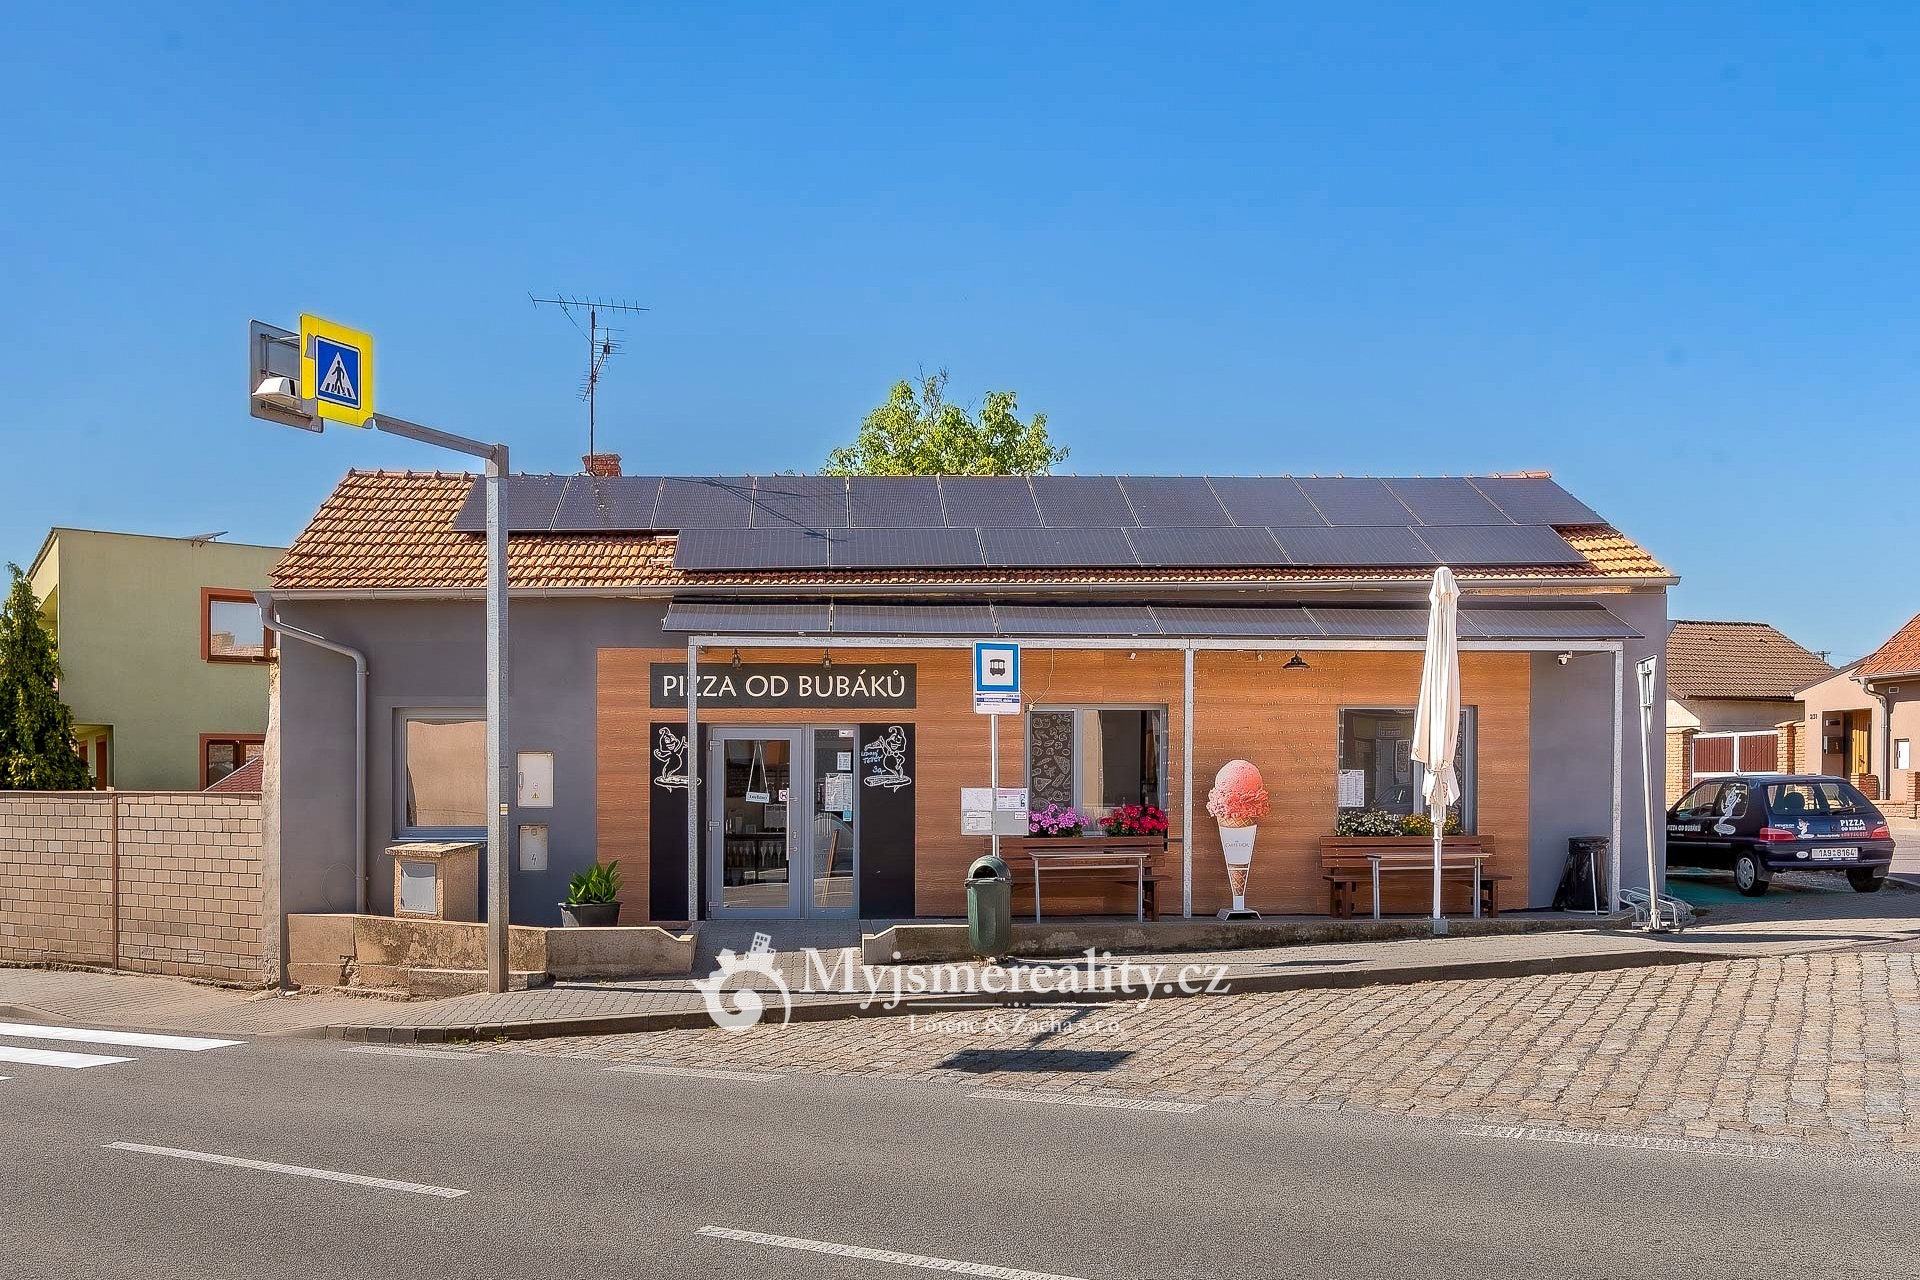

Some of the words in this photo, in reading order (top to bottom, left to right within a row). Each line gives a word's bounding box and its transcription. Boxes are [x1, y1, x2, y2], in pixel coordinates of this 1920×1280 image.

[745, 675, 789, 697] OD
[798, 669, 905, 697] BUBÁKŮ
[1840, 819, 1866, 827] PIZZA
